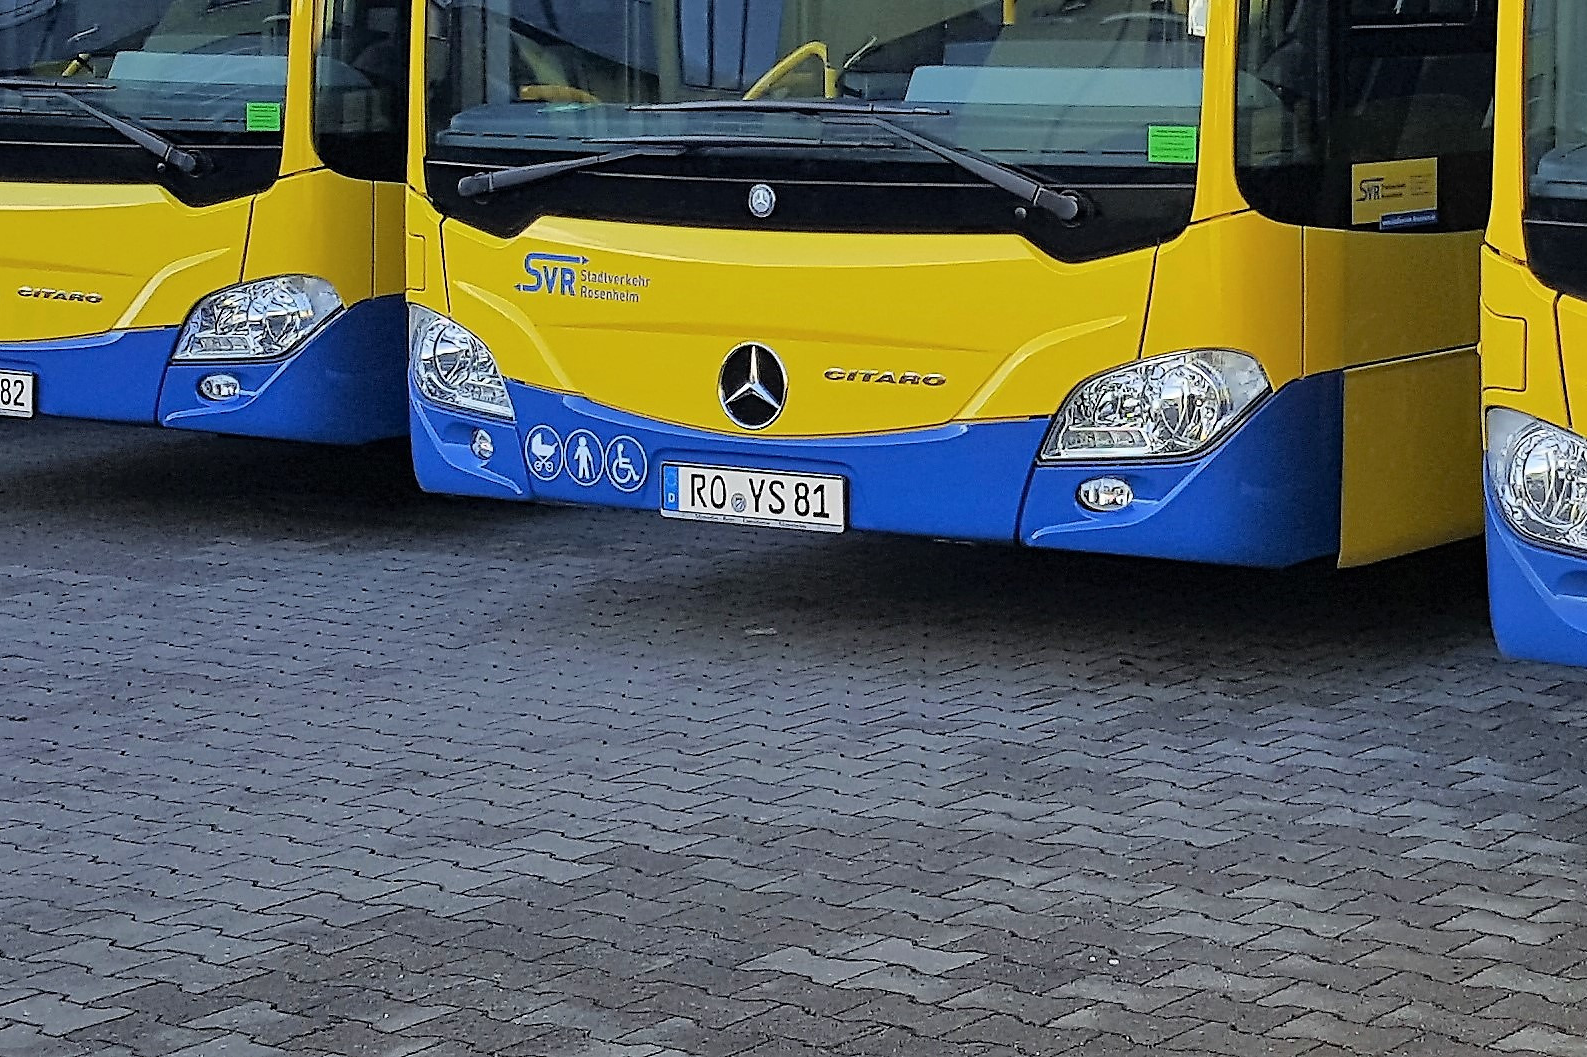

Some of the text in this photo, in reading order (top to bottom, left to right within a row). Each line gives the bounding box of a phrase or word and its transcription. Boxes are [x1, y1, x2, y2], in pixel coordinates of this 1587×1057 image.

[514, 252, 590, 297] SVR
[580, 269, 651, 288] Stadtverkehr
[17, 285, 103, 304] CITARO
[580, 285, 640, 303] Rosenheim
[824, 366, 947, 387] CITARO
[0, 378, 25, 407] 82
[690, 473, 830, 519] RO YS 81
